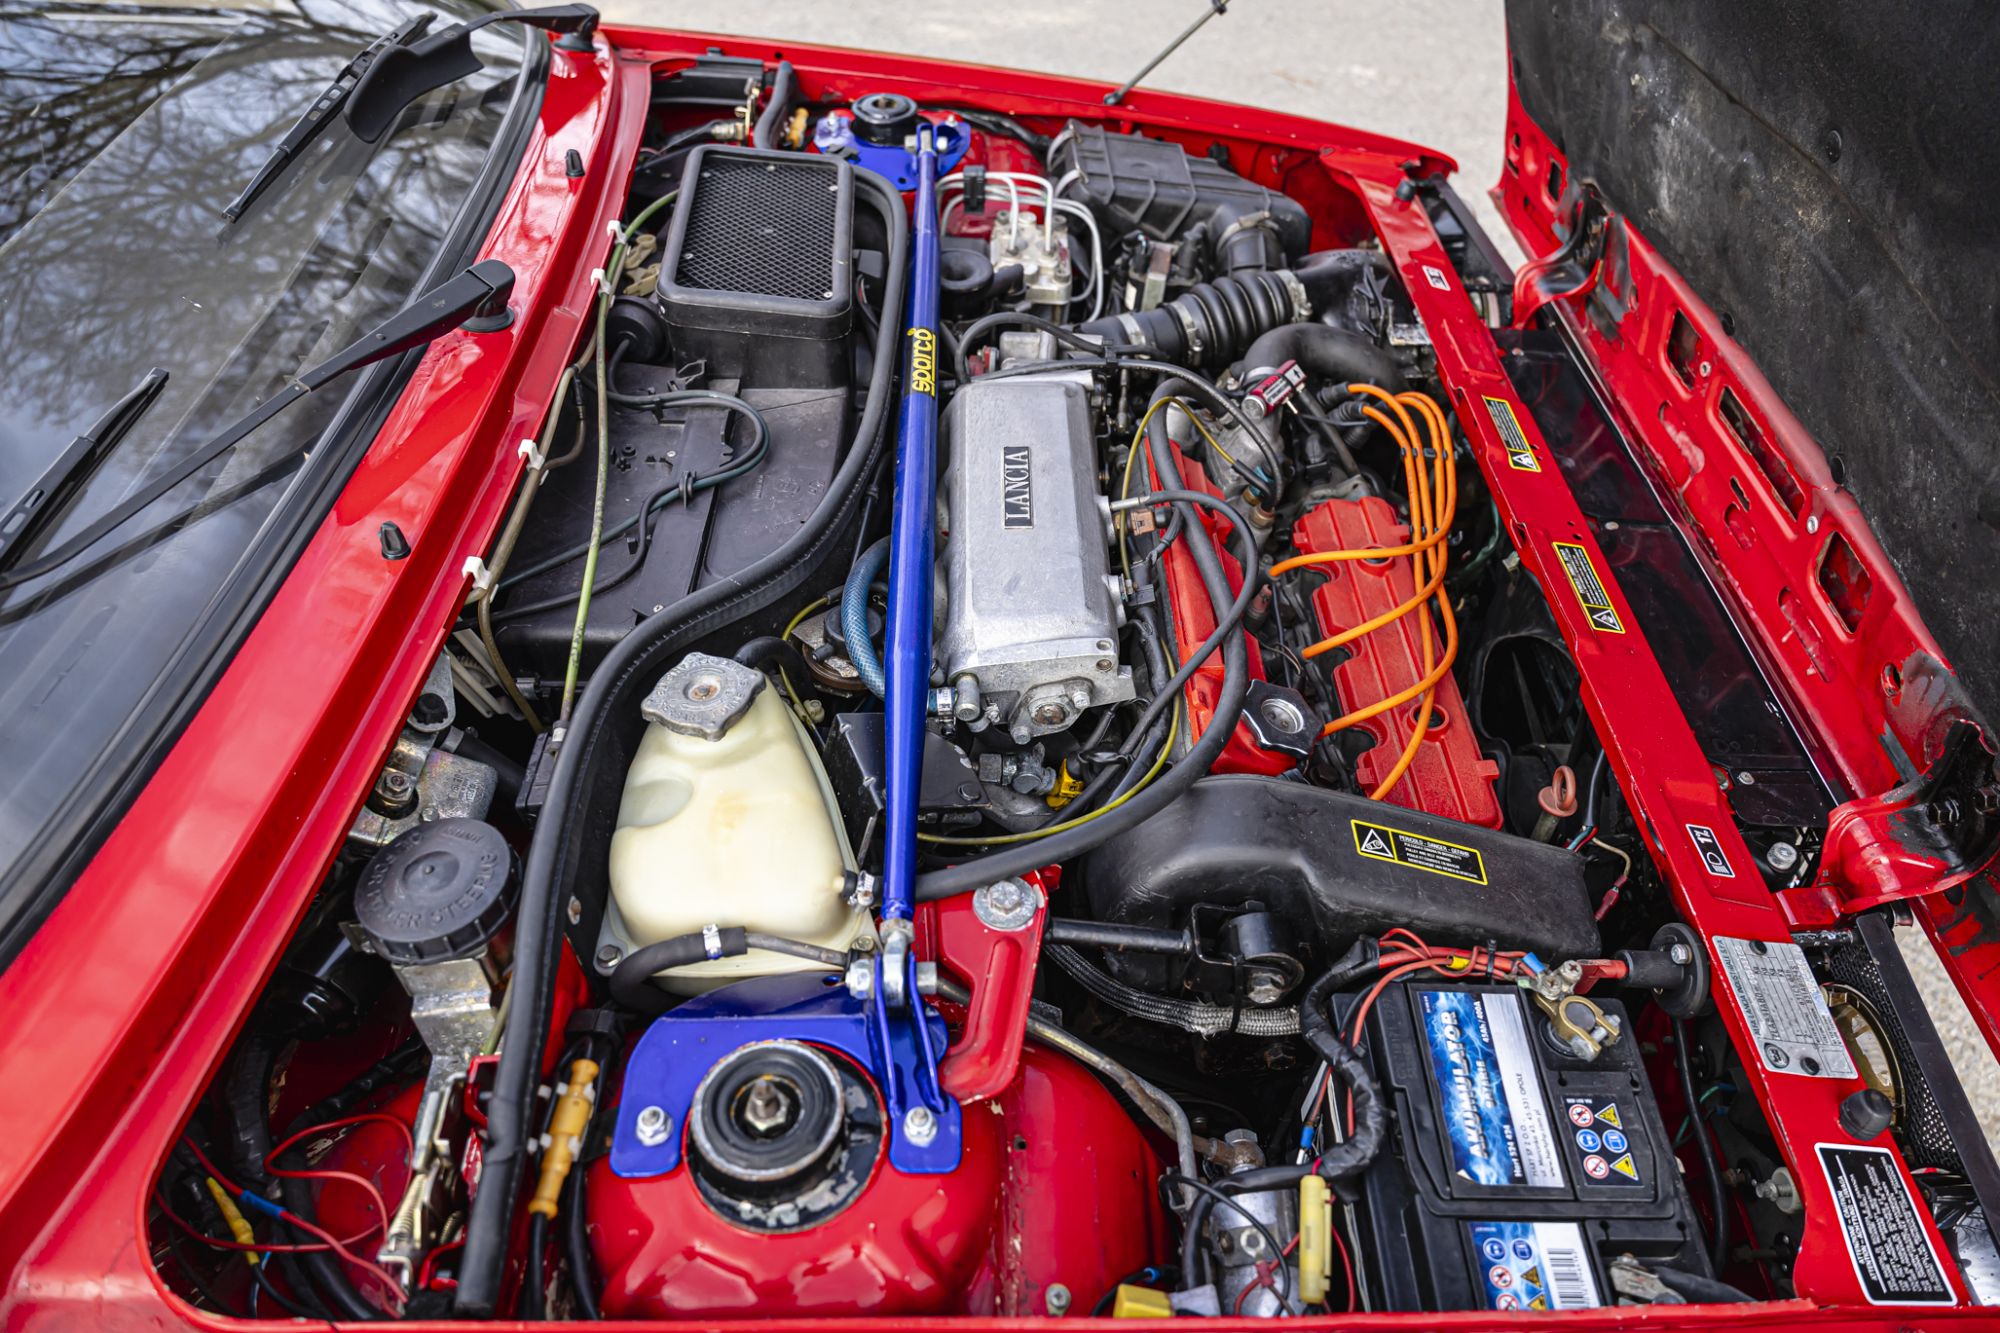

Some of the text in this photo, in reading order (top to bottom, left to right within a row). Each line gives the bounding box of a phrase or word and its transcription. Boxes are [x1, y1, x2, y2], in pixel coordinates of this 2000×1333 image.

[907, 328, 936, 396] sparco
[1004, 449, 1031, 521] LANCIA
[1440, 1010, 1488, 1158] AKUMULATOR
[1515, 1073, 1526, 1094] OPOLE
